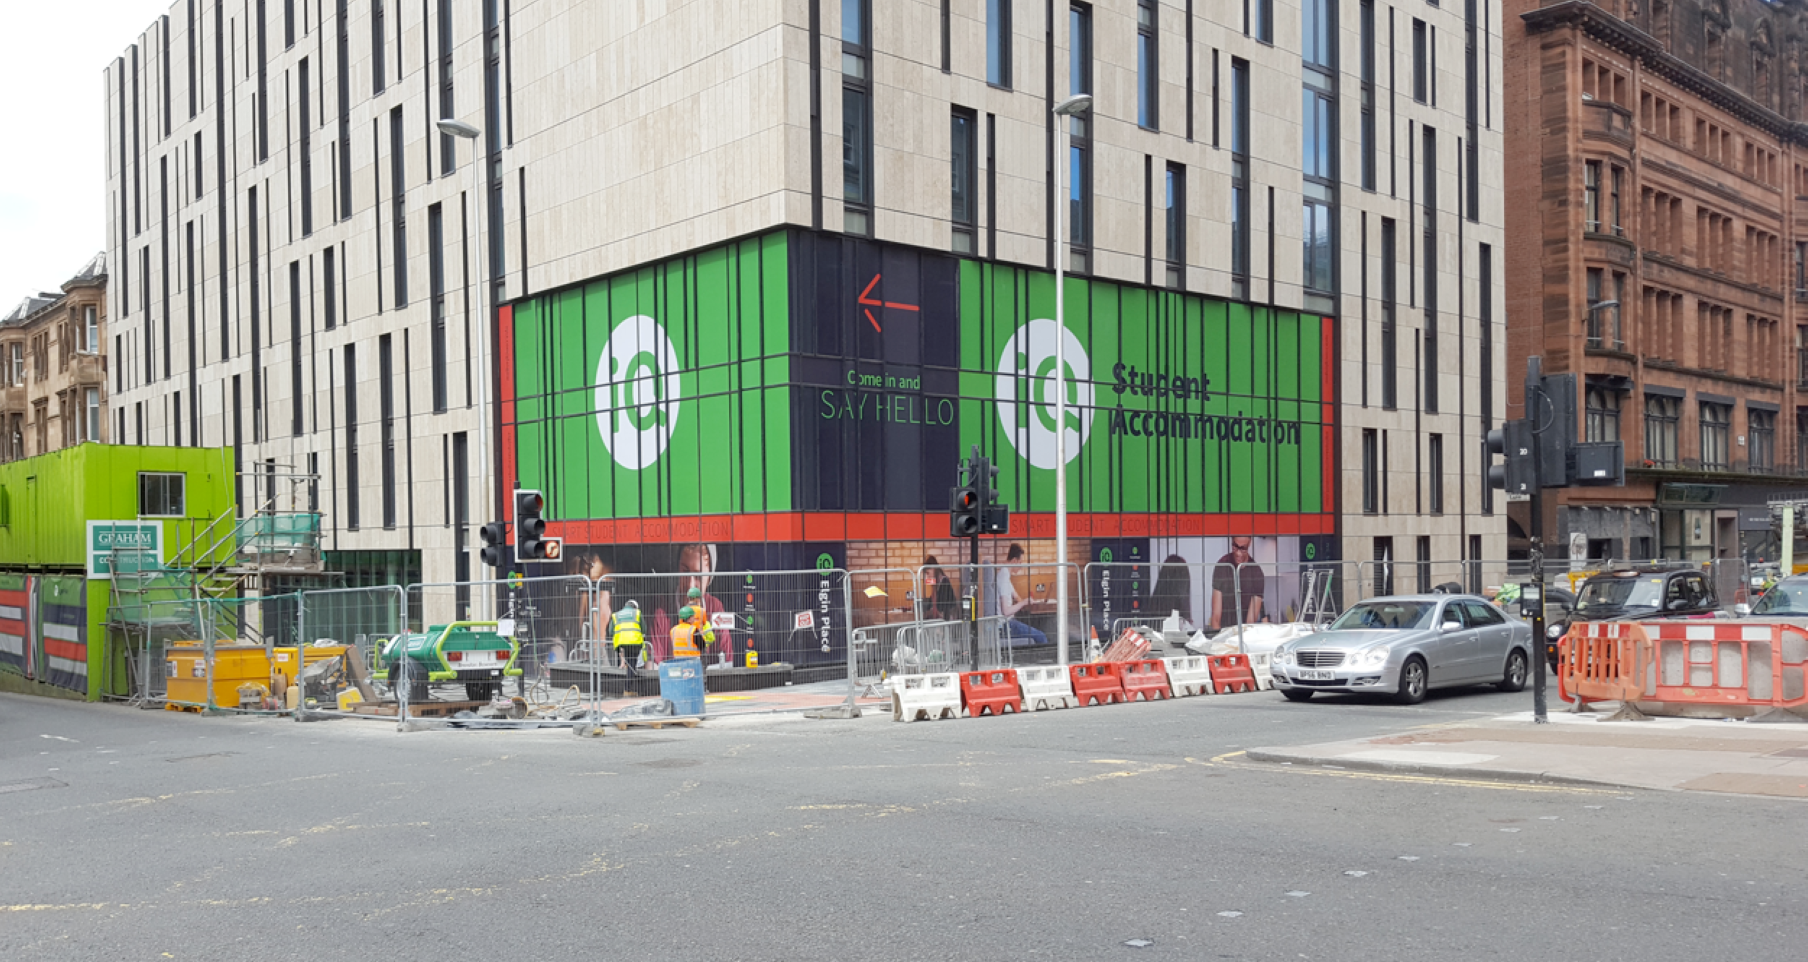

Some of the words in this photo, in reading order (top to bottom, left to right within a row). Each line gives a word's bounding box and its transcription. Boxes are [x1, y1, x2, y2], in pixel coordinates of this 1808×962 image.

[847, 370, 882, 387] Come
[885, 372, 896, 388] in
[899, 375, 920, 390] and
[1112, 362, 1210, 401] Student
[821, 390, 868, 419] SAY
[876, 394, 954, 425] HELLO
[1112, 404, 1300, 445] Accommodation
[584, 523, 628, 539] STUDENT
[634, 520, 729, 538] ACCOMMODATION
[819, 580, 831, 613] Elgin
[821, 617, 831, 653] Place
